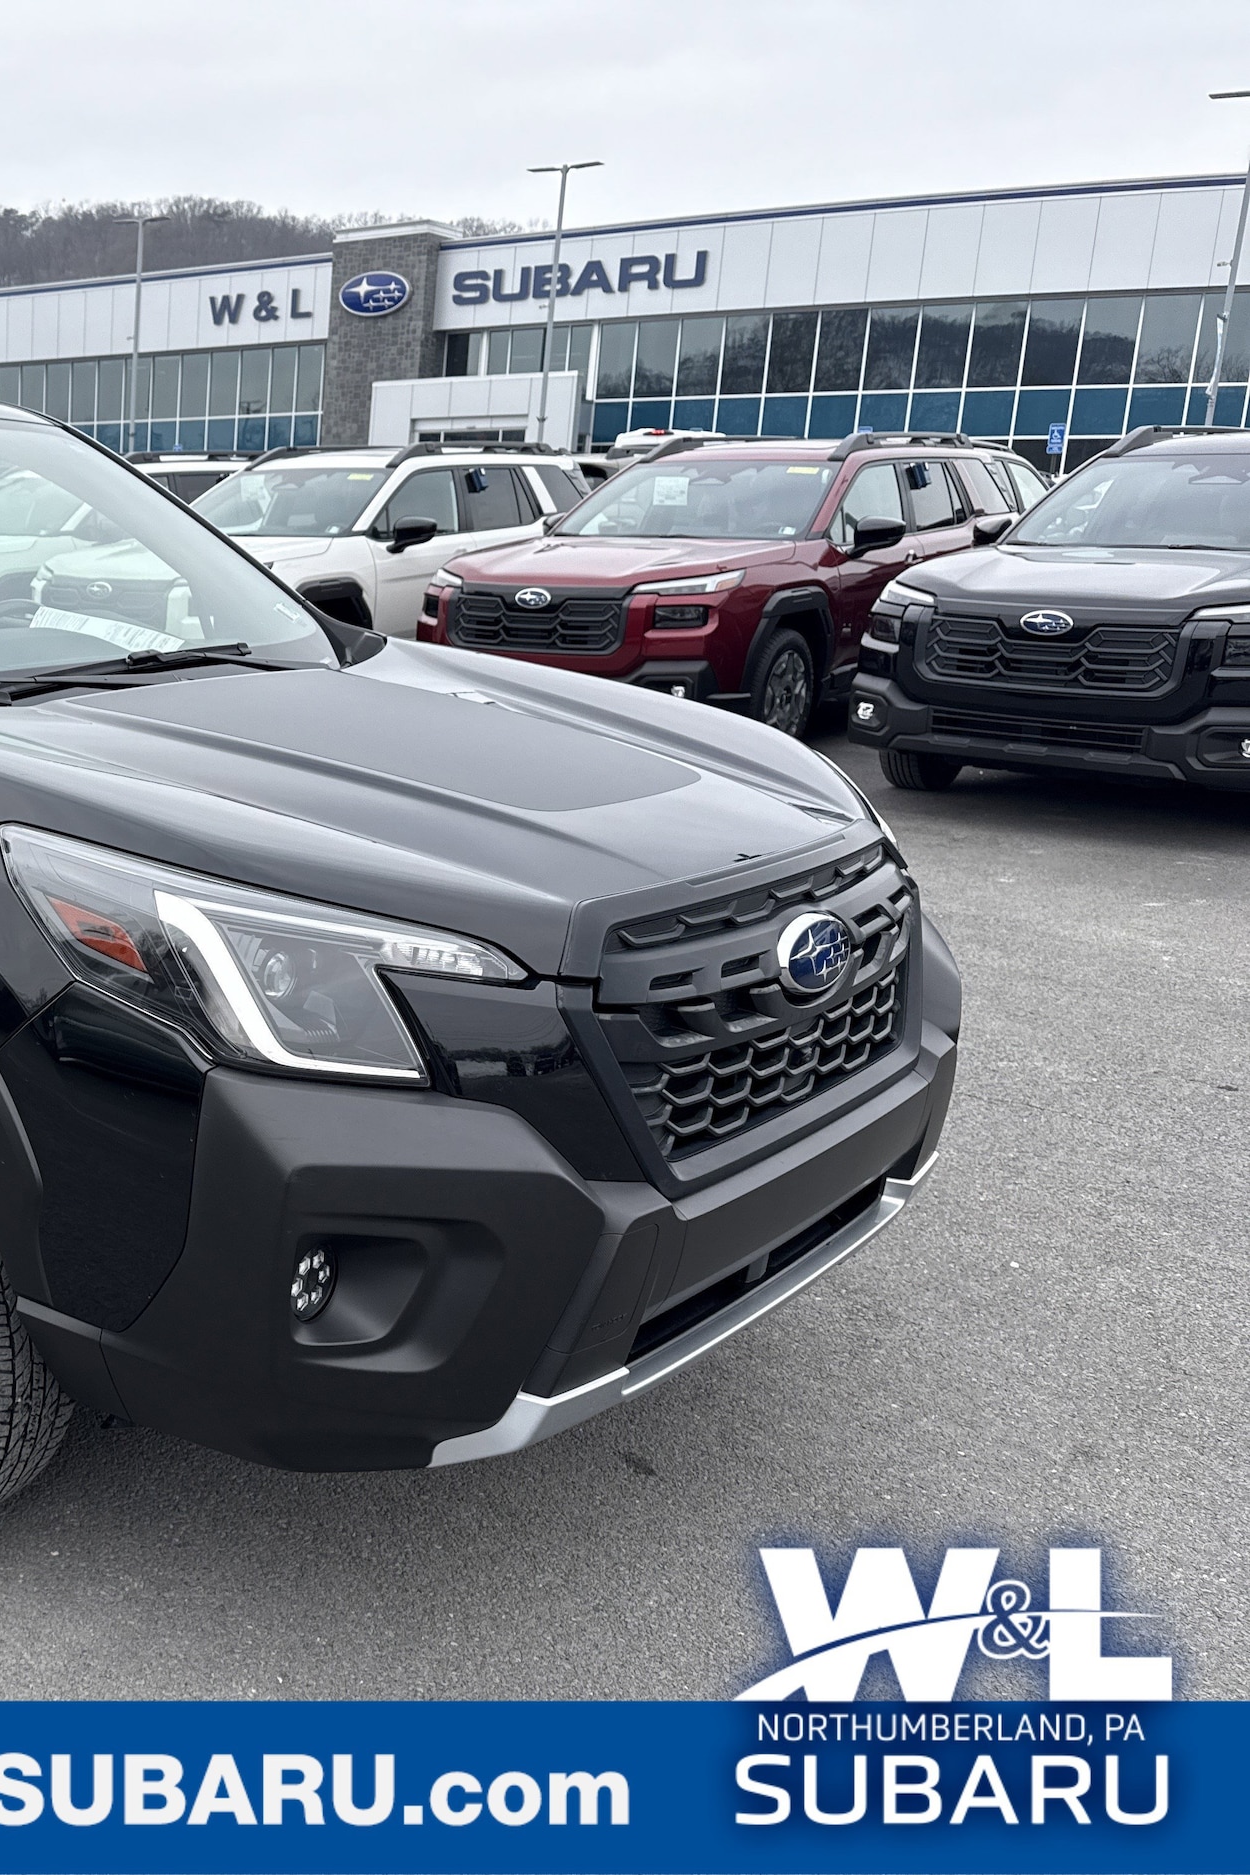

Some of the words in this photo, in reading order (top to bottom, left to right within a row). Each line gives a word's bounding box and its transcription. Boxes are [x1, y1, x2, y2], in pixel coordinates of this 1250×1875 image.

[452, 250, 708, 306] SUBARU
[209, 293, 246, 326] W
[253, 290, 280, 322] &
[290, 288, 313, 319] L
